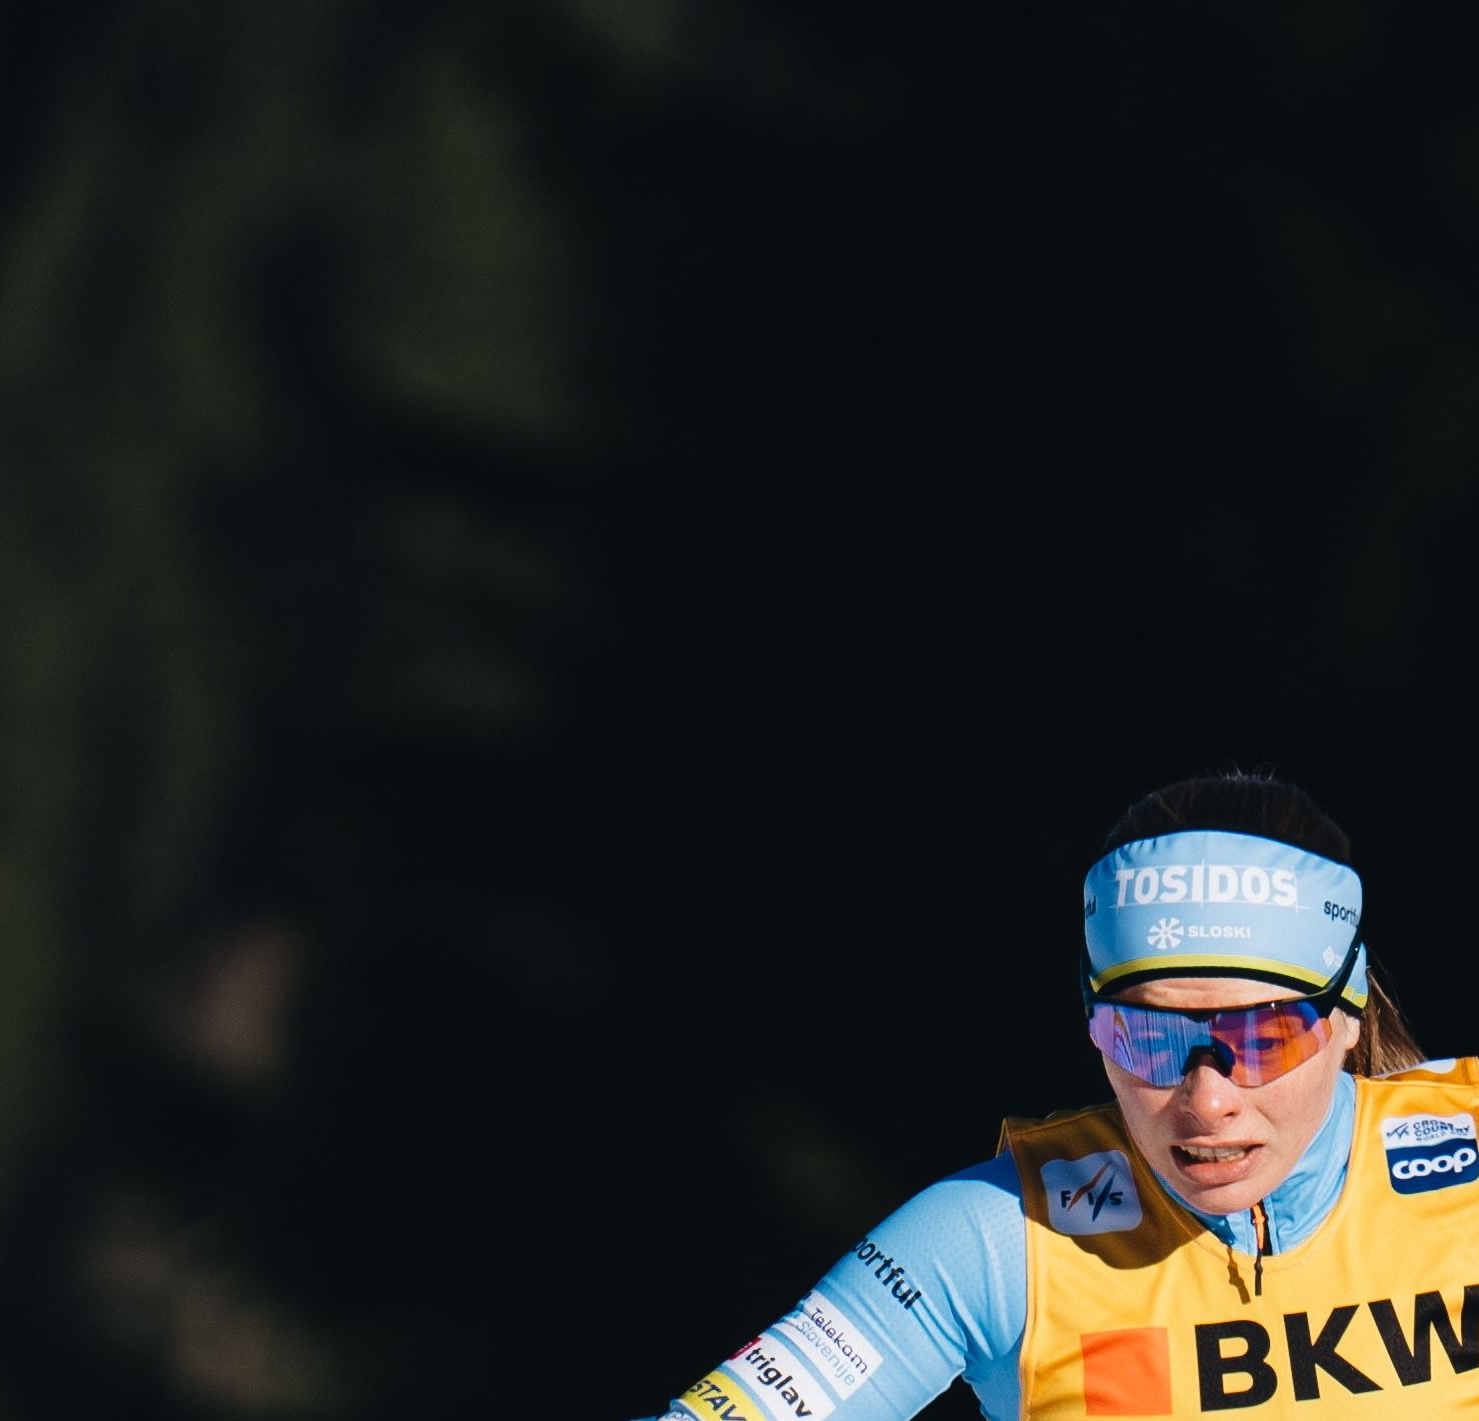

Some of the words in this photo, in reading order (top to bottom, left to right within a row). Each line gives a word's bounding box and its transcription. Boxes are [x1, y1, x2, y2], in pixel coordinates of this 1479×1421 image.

[1115, 864, 1298, 908] TOSIDOS
[1188, 925, 1252, 939] SLOSKI
[1392, 1147, 1477, 1180] coop
[1060, 1190, 1124, 1208] FIS
[799, 1320, 856, 1386] Slovenije
[811, 1307, 868, 1374] Telekom
[745, 1347, 813, 1418] triglav
